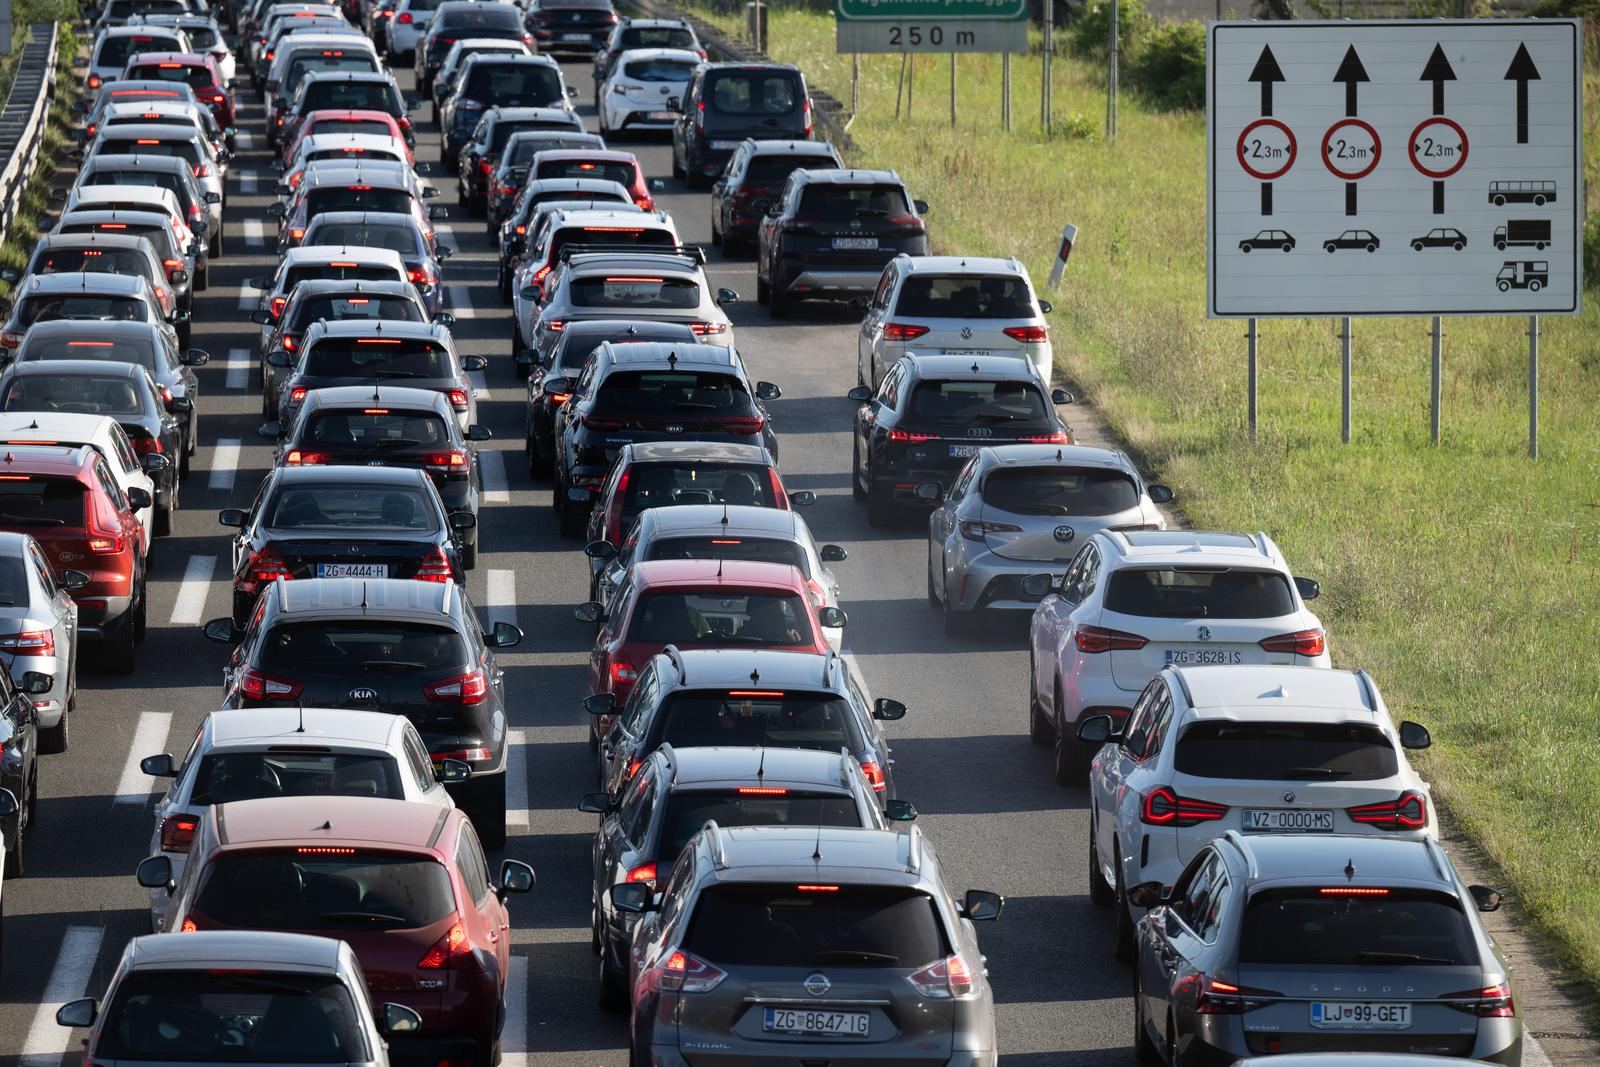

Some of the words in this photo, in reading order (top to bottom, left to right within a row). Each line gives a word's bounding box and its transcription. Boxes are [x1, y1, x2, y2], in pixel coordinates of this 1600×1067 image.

[889, 26, 944, 46] 250
[956, 31, 975, 45] m
[325, 565, 339, 577] ZG
[1173, 651, 1188, 663] ZG
[354, 690, 373, 699] KIA
[1253, 812, 1269, 827] VZ
[776, 1011, 795, 1028] ZG
[1324, 1005, 1342, 1021] LJ
